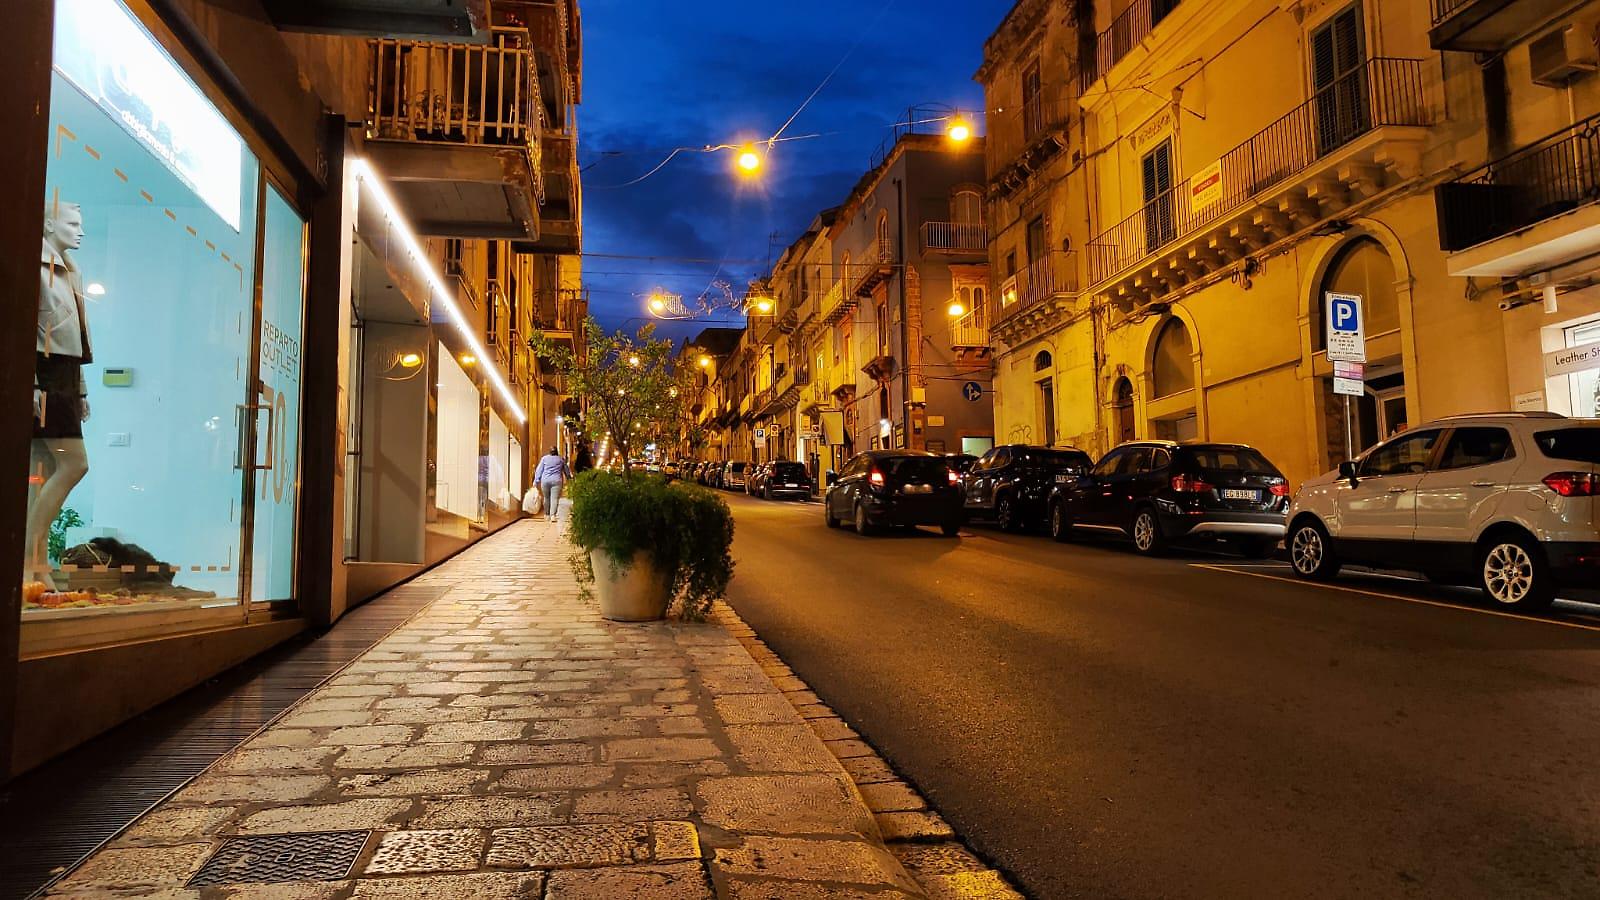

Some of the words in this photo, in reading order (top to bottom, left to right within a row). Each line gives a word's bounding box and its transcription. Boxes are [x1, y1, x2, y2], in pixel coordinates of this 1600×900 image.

[1336, 303, 1352, 327] P
[263, 320, 299, 357] REPARTO
[262, 342, 297, 375] OUTLET
[1555, 352, 1588, 365] Leather
